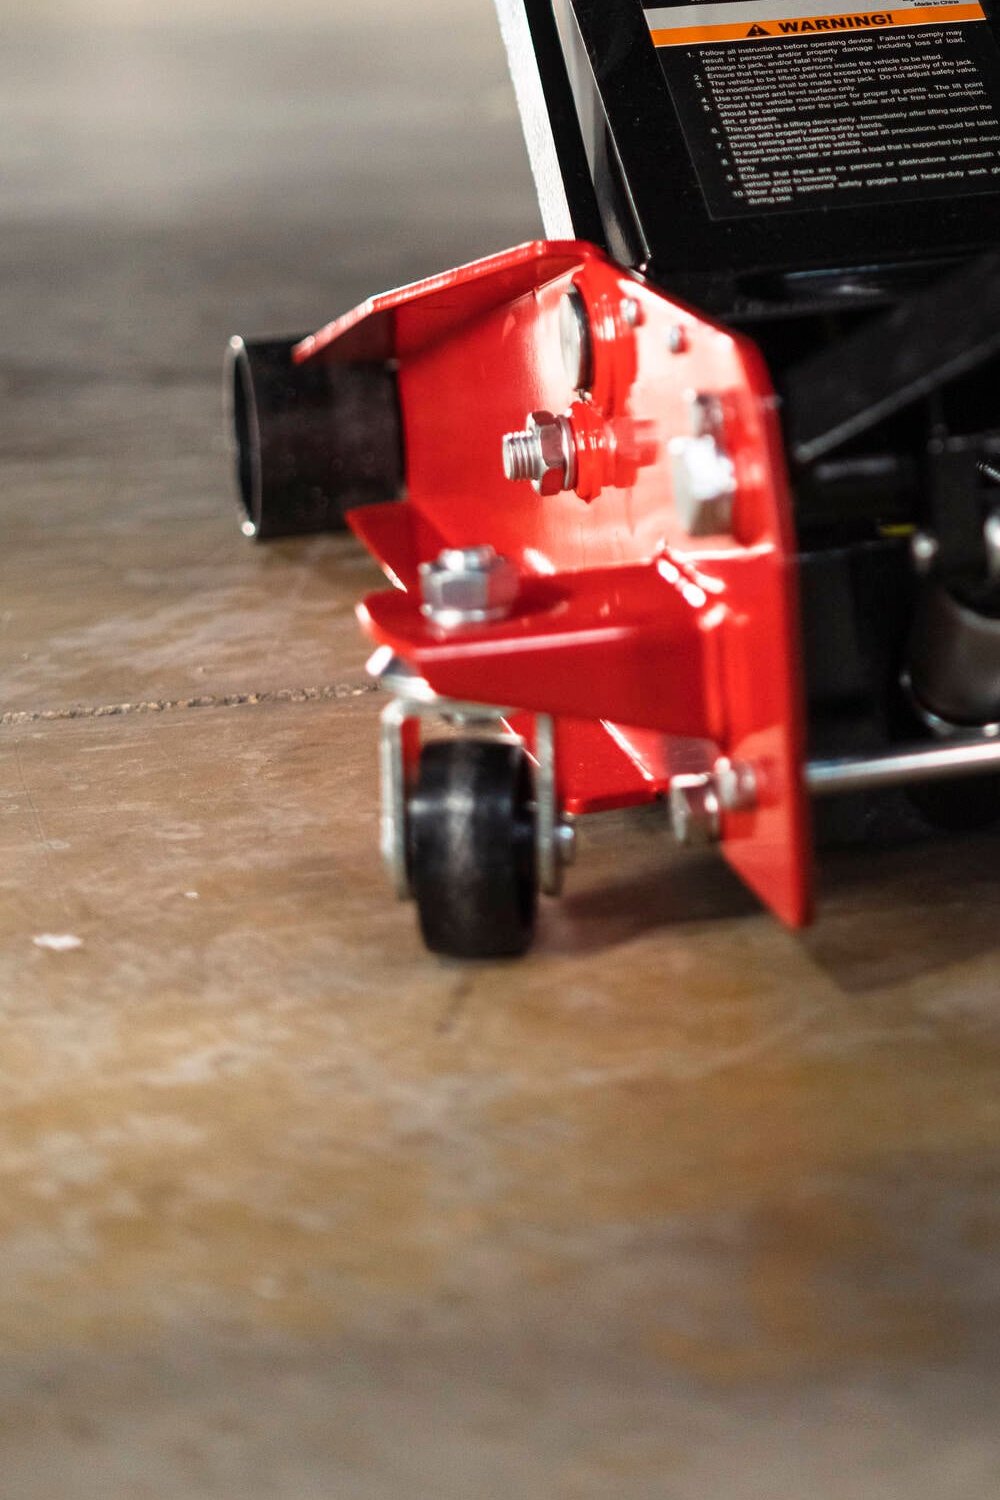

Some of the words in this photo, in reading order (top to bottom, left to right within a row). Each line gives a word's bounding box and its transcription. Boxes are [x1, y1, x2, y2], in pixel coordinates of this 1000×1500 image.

[778, 13, 895, 34] WARNING!
[740, 53, 773, 62] personal
[806, 48, 838, 56] property
[899, 63, 930, 71] capacity
